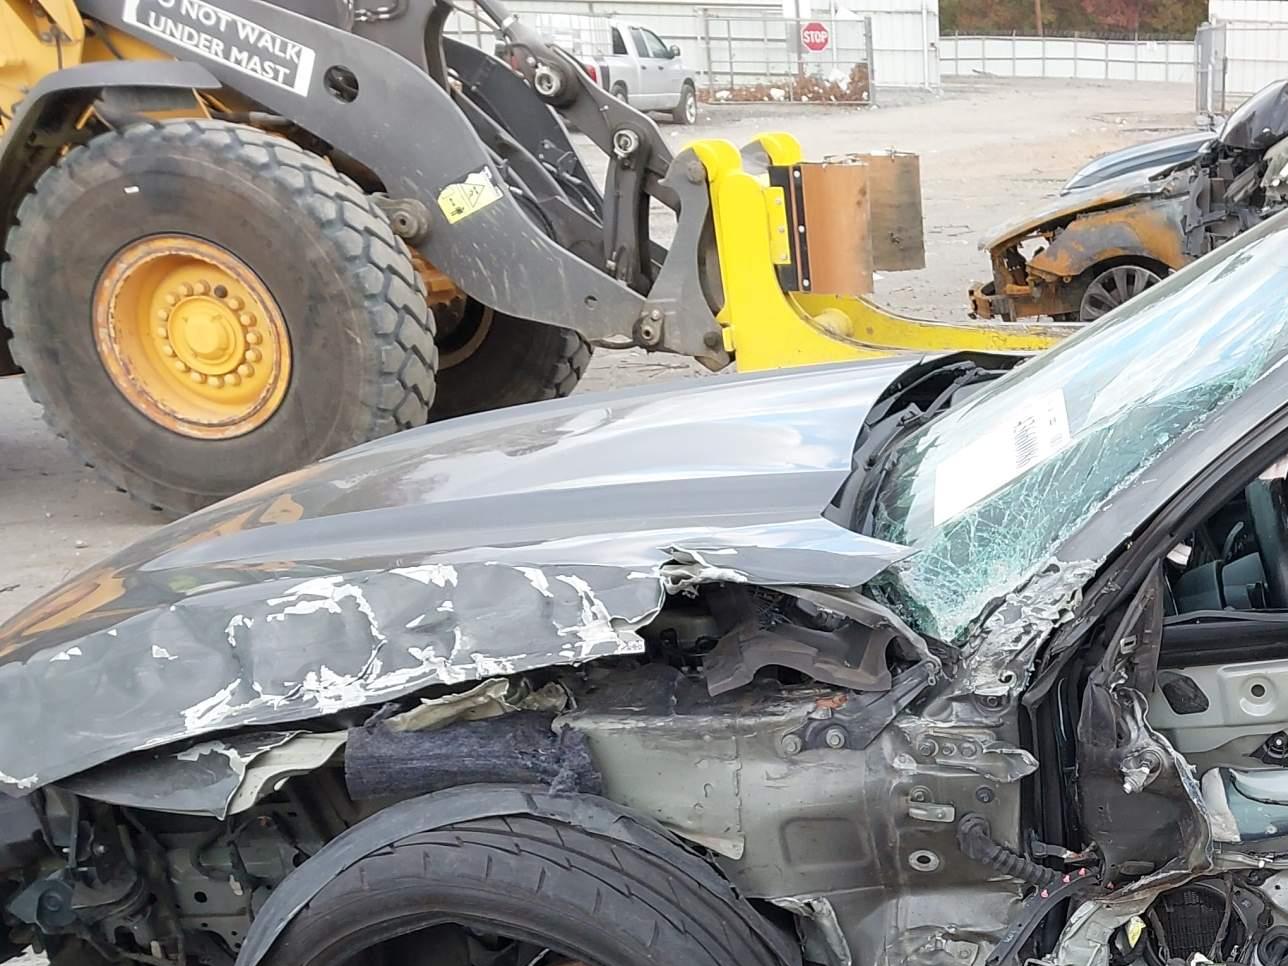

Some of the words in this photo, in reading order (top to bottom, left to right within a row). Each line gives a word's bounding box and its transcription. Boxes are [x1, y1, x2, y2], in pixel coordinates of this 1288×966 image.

[148, 10, 225, 59] UNDER
[229, 46, 291, 85] MAST
[180, 0, 234, 33] NOT
[236, 19, 301, 64] WALK
[803, 30, 828, 43] STOP
